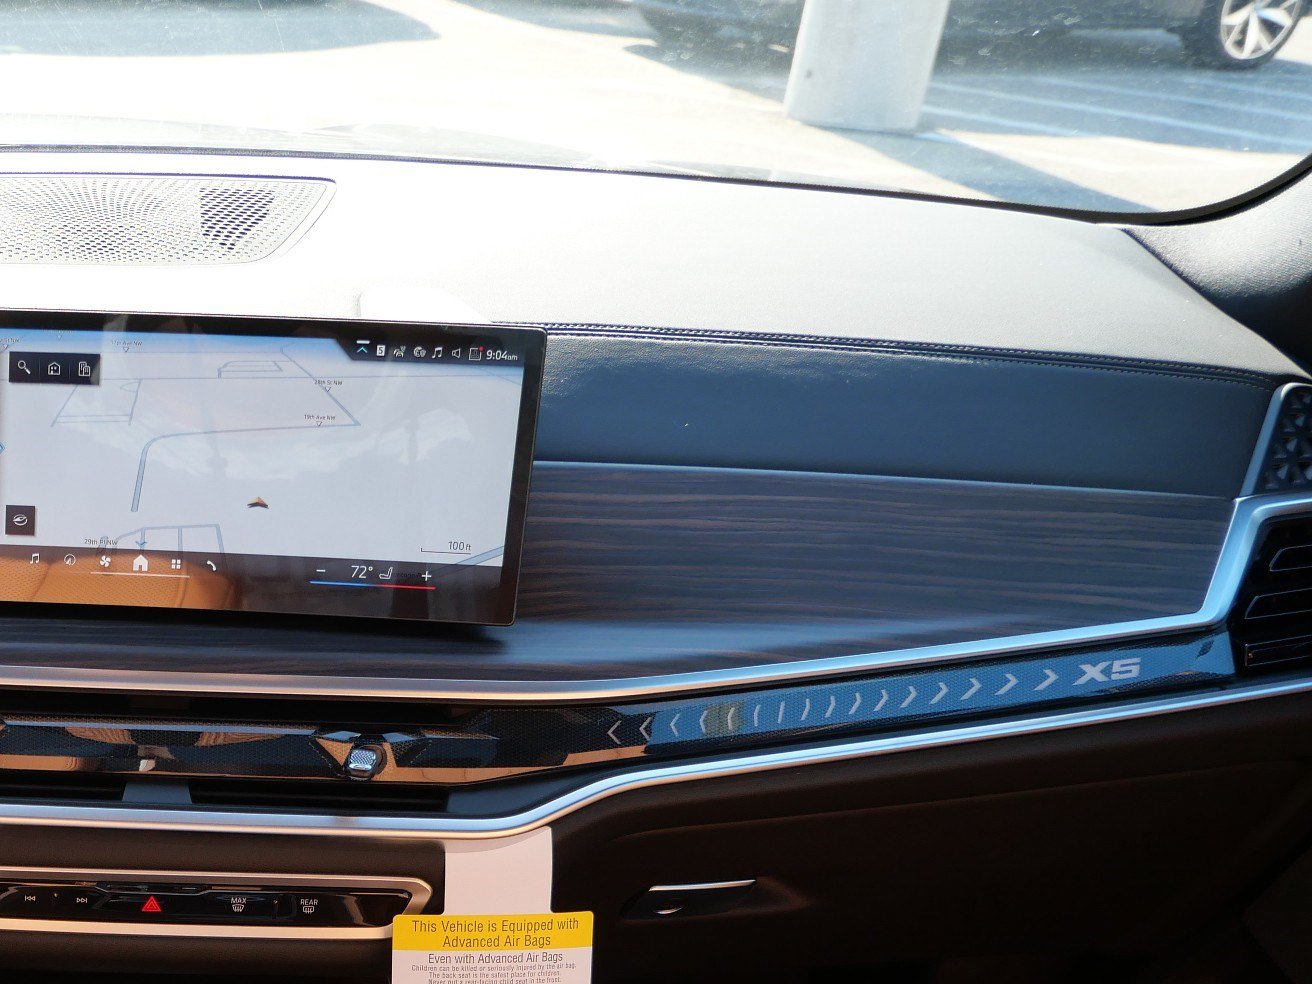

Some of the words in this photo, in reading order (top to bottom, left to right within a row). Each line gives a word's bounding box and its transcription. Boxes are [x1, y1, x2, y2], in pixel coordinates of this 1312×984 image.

[448, 541, 465, 551] 100
[465, 543, 471, 551] ft
[1072, 657, 1141, 686] X5
[300, 898, 319, 906] REAR
[412, 920, 437, 932] This
[441, 920, 484, 932] Vehicle
[488, 920, 497, 932] is
[501, 918, 554, 934] Equipped
[557, 917, 579, 930] with
[442, 935, 500, 948] Advanced
[504, 935, 520, 947] Air
[524, 934, 551, 949] Bags
[428, 953, 451, 964] Even
[454, 953, 475, 964] with
[477, 953, 524, 964] Advanced
[526, 952, 539, 963] Air
[542, 951, 563, 964] Bags
[411, 964, 437, 972] Children
[451, 964, 459, 972] be
[461, 964, 478, 972] killed
[516, 964, 537, 972] injured
[538, 963, 545, 972] by
[442, 971, 457, 979] back
[510, 971, 526, 979] place
